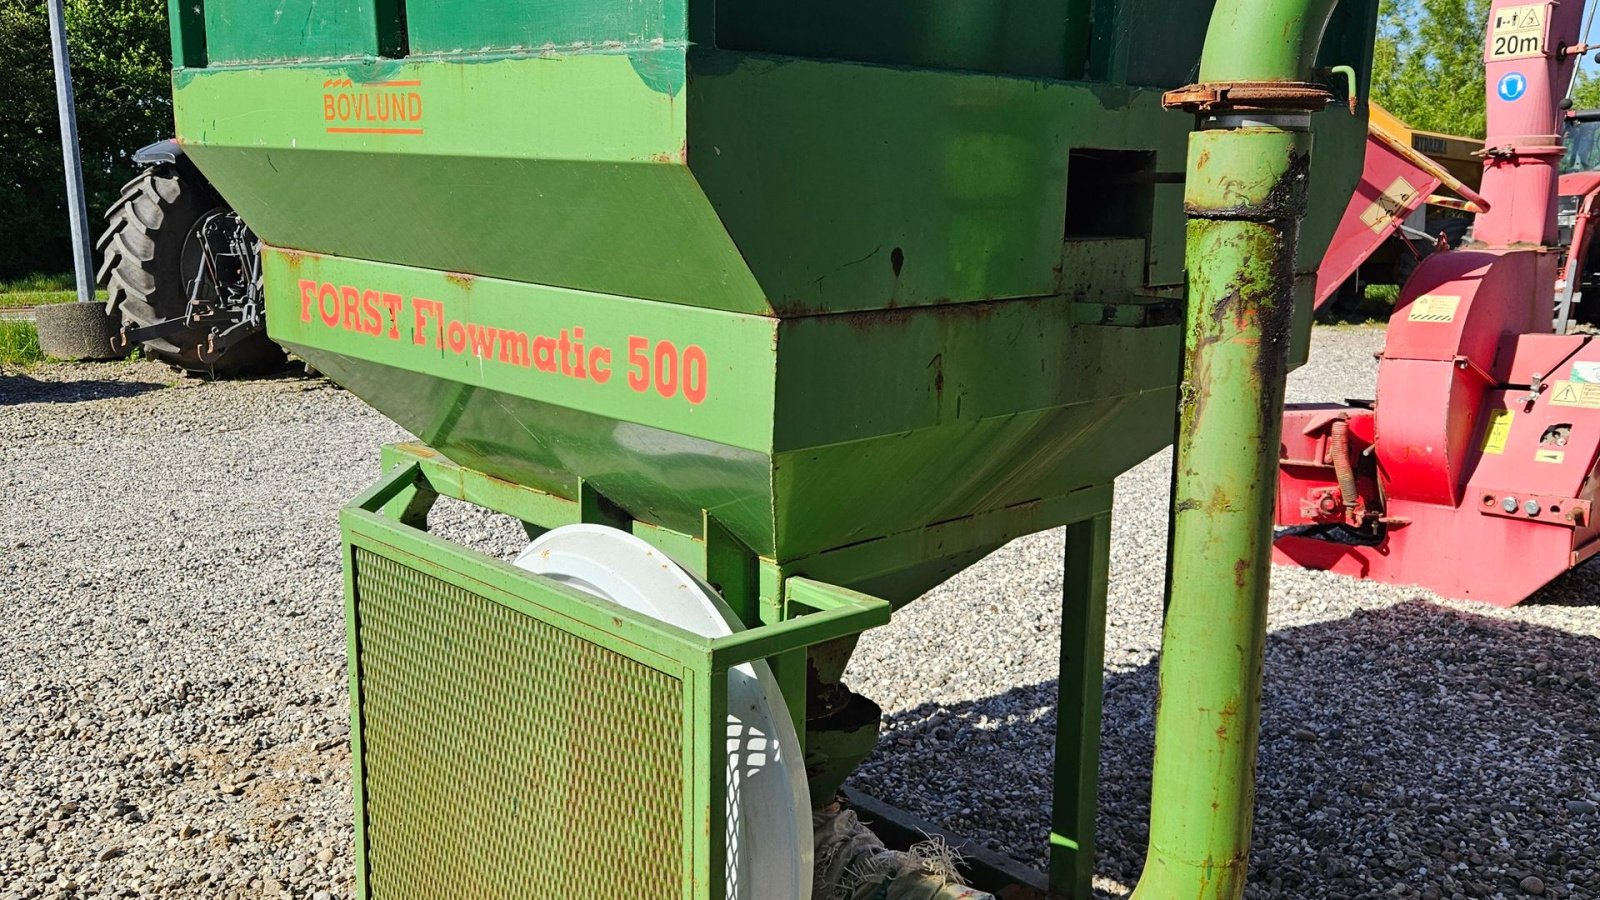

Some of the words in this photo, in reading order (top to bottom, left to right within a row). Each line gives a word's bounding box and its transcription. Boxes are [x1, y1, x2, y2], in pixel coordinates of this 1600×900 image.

[1495, 35, 1538, 55] 20m
[298, 279, 403, 340] FORST
[411, 297, 612, 384] Flowmatic
[627, 335, 708, 405] 500
